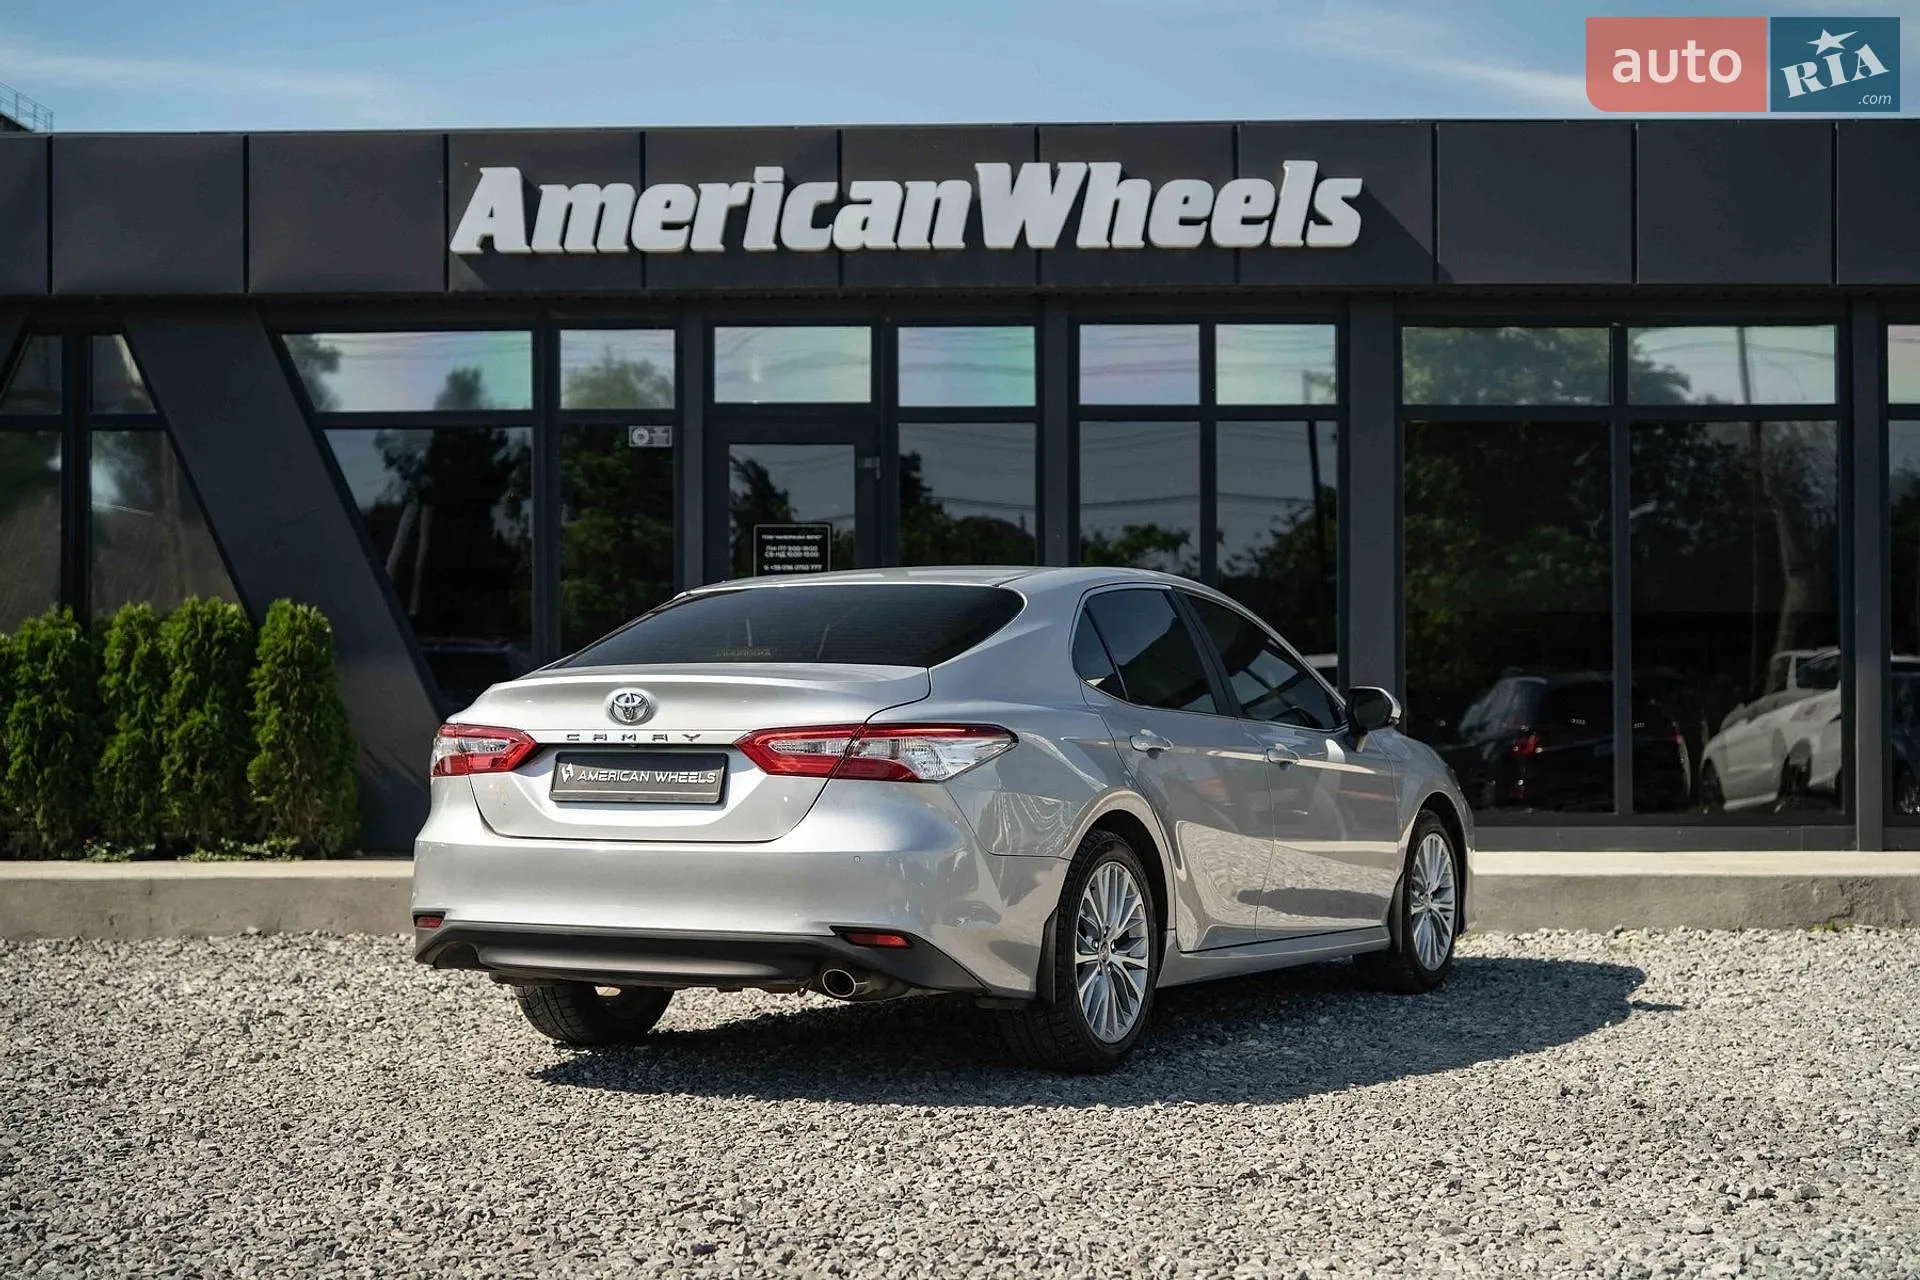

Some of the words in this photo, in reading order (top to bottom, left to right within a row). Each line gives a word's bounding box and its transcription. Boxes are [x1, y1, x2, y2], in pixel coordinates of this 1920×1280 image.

[449, 159, 1363, 255] AmericanWheels
[577, 770, 650, 782] AMERICAN
[654, 771, 716, 784] WHEELS
